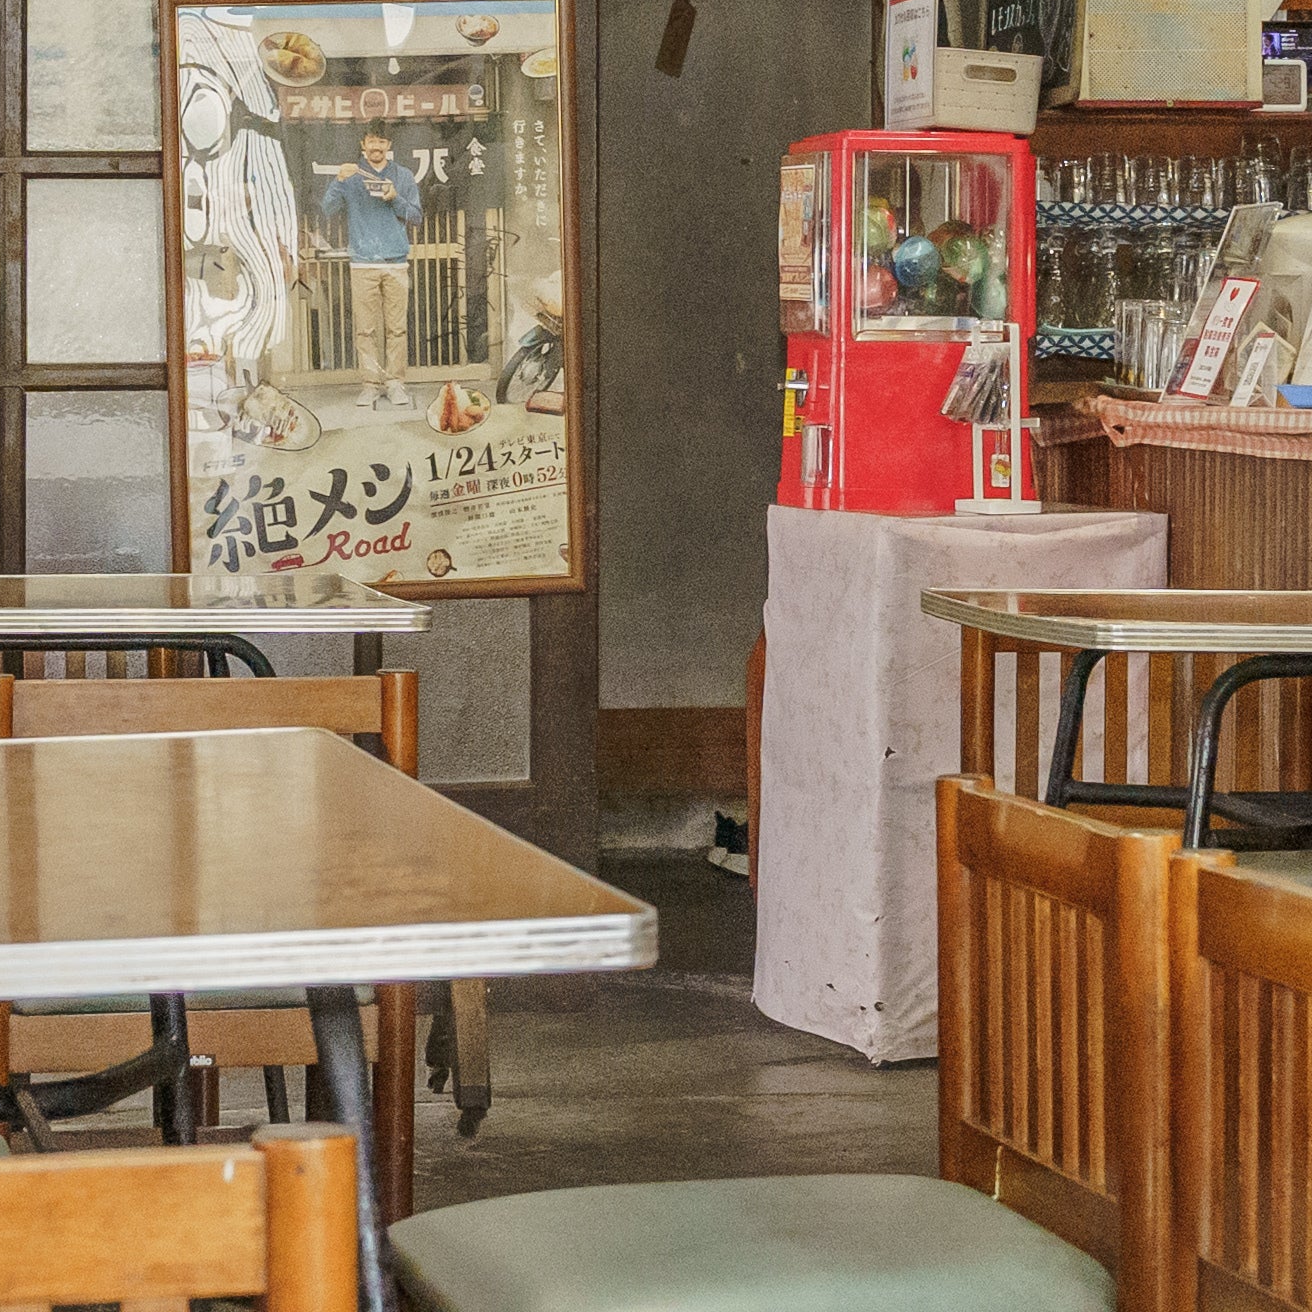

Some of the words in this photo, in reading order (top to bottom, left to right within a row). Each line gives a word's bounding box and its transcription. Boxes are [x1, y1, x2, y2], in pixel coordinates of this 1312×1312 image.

[288, 95, 353, 118] アサヒ
[396, 93, 460, 117] ビール
[513, 119, 528, 201] 行きますか。
[533, 119, 547, 227] さて、いただきに
[425, 442, 498, 482] 1/24
[499, 441, 565, 469] スタート
[204, 461, 413, 573] 絶メシ
[320, 521, 412, 562] Road
